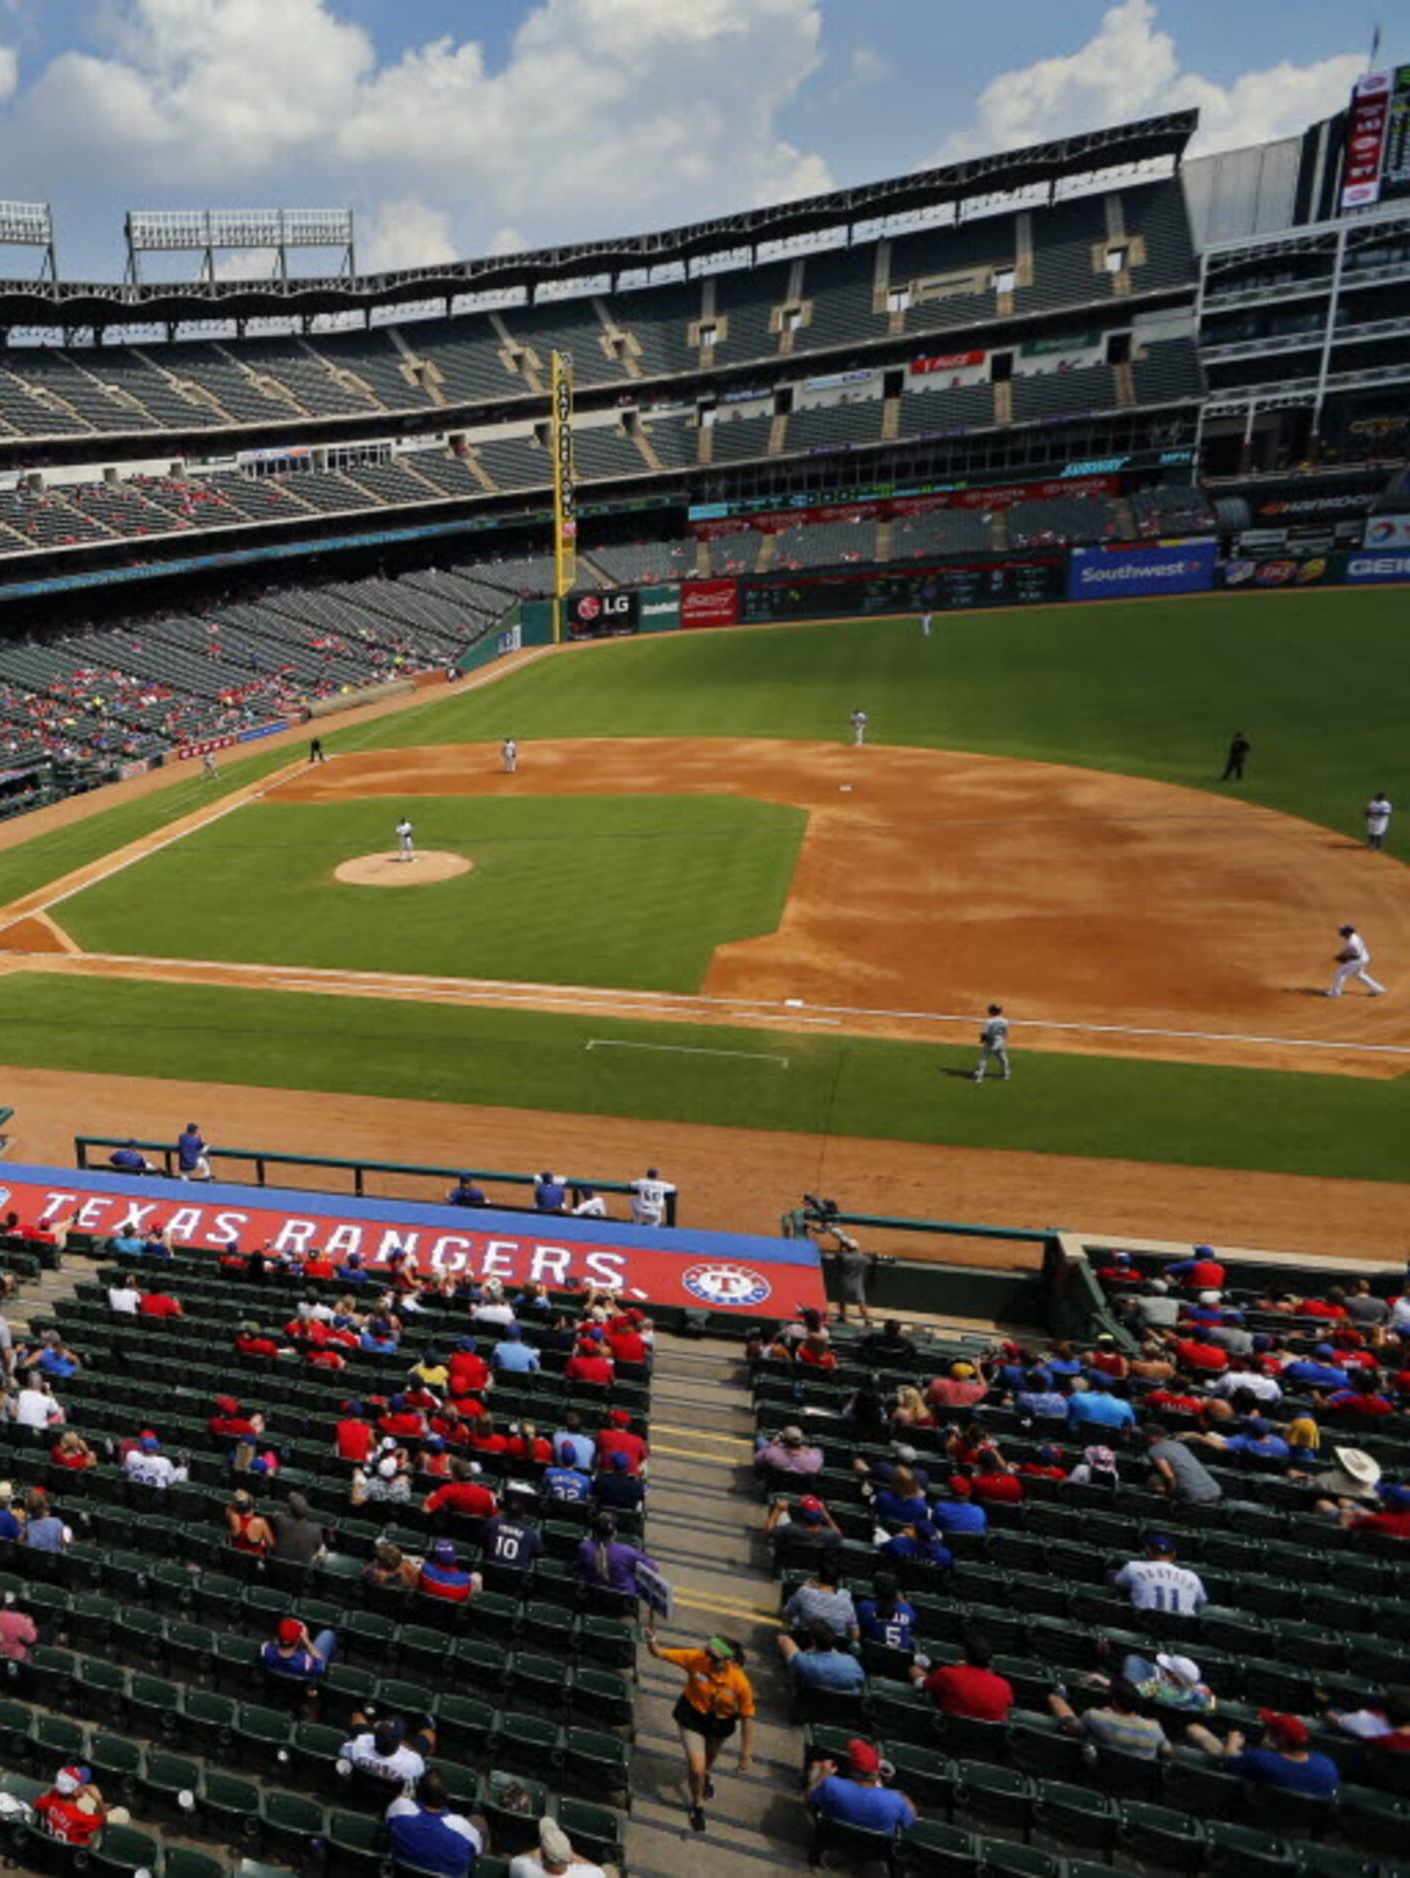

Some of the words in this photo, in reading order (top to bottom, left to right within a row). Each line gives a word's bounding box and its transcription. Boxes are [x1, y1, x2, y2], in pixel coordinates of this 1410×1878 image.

[1082, 562, 1185, 583] Southwest
[603, 595, 629, 616] LG
[39, 1191, 248, 1244] TEXAS
[494, 1536, 519, 1560] 10
[1153, 1585, 1180, 1612] 11
[885, 1626, 902, 1649] 5
